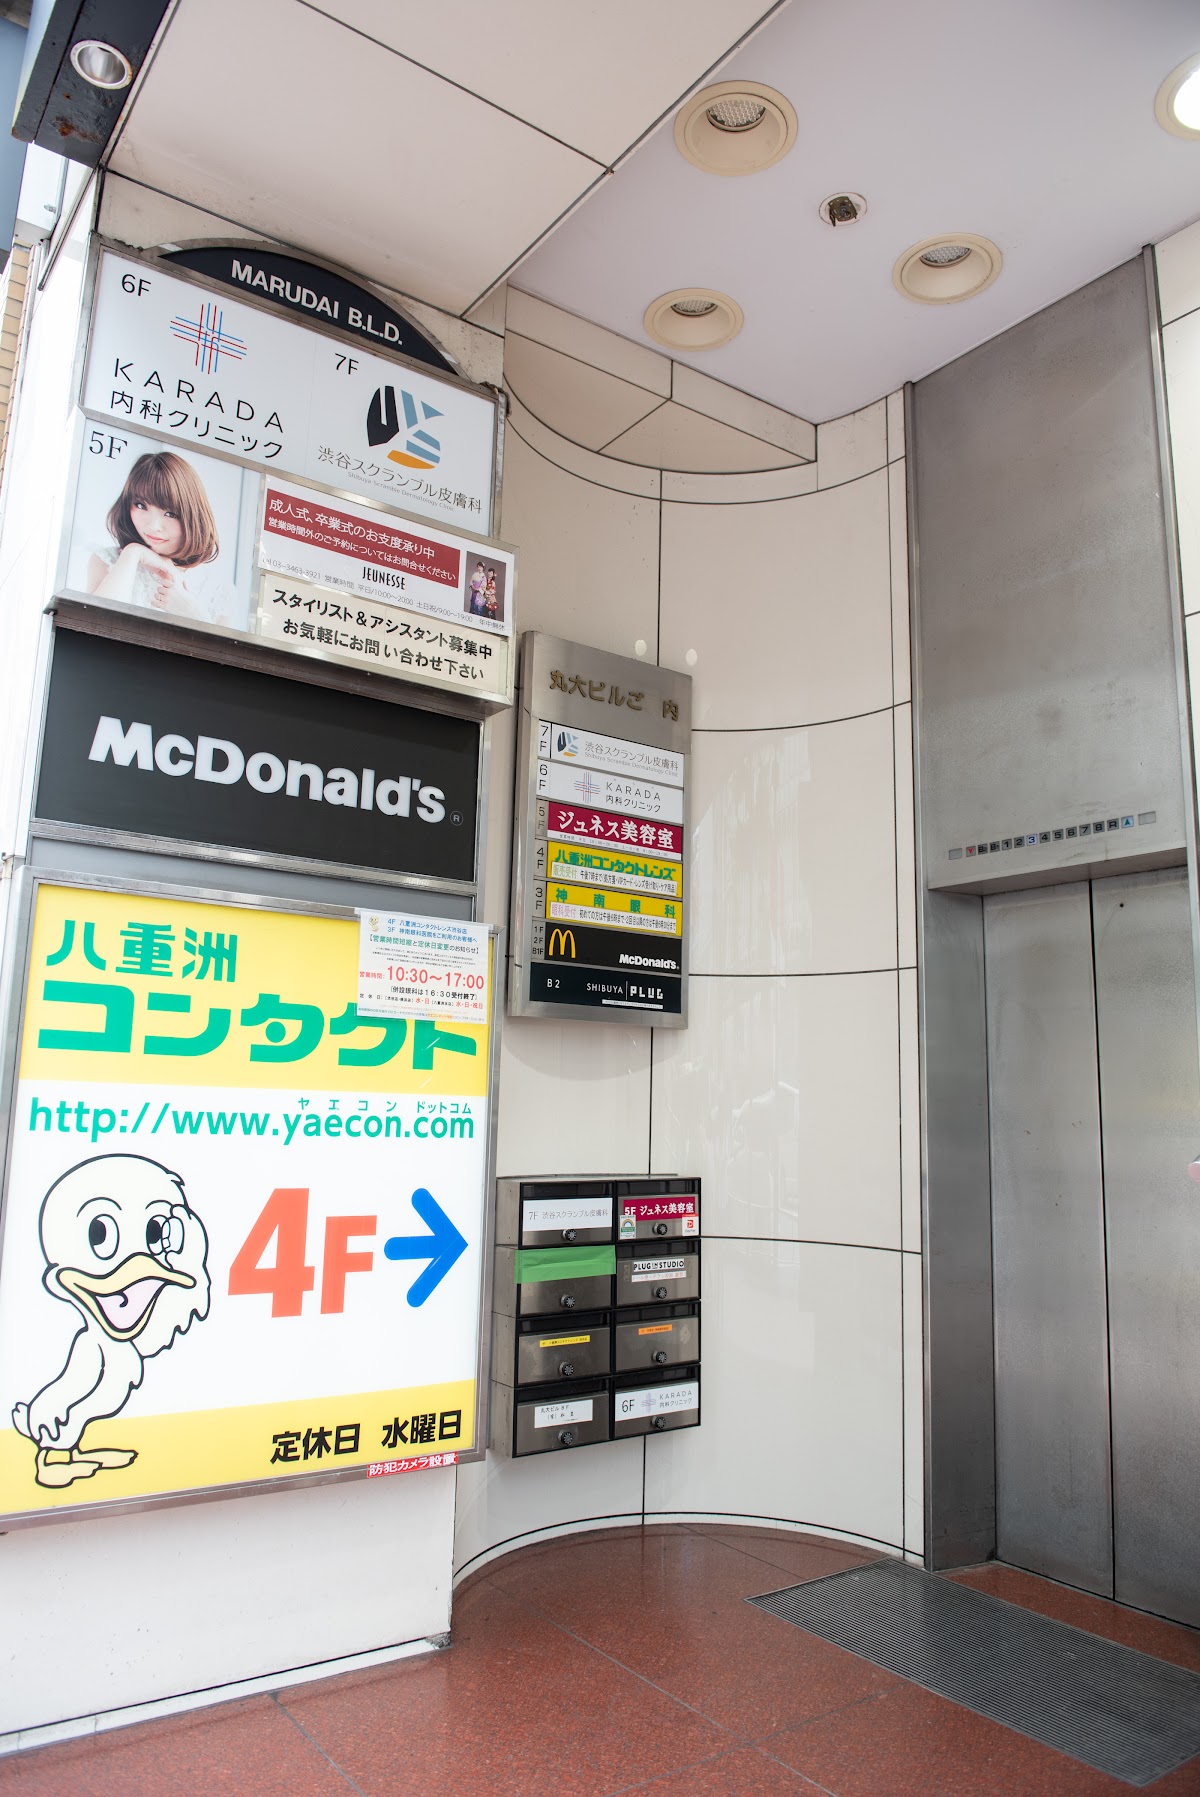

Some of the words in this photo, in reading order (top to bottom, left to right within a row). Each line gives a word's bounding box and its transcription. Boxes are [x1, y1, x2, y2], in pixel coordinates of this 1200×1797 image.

[121, 273, 152, 298] 6F
[231, 259, 339, 319] MARUDAI
[347, 307, 403, 345] B.L.D.
[334, 353, 359, 376] 7F
[114, 358, 284, 434] KARADA
[110, 390, 283, 459] 内科クリニック
[88, 431, 128, 460] 5F
[318, 445, 482, 513] 渋谷スクランブル皮膚科
[348, 471, 372, 485] Shibuya
[373, 479, 401, 494] Scramble
[401, 487, 437, 507] Dermatology
[438, 500, 455, 512] Clinic
[269, 498, 435, 559] 成人式、卒業式のお支度承り中
[268, 517, 456, 581] 営業時間外のご予約についてはお問合せください
[325, 575, 355, 590] 営業時間
[362, 566, 406, 590] JEUNESSE
[283, 618, 484, 680] お気軽にお問い合わせ下さい
[584, 740, 679, 771] 渋谷スクランブル皮膚科
[88, 716, 446, 824] McDonald's
[605, 781, 661, 801] KARADA
[605, 795, 661, 813] 内科クリニック
[557, 810, 674, 849] ジュネス美容室
[1016, 837, 1023, 846] 2
[1028, 835, 1036, 843] 3
[1041, 833, 1048, 841] 4
[1054, 831, 1061, 839] 5
[1068, 828, 1075, 837] 6
[1081, 825, 1088, 834] 7
[1095, 823, 1103, 832] 8
[1109, 820, 1117, 829] R
[552, 864, 577, 879] 販売受付
[555, 849, 676, 882] 八重洲コンタクトレンズ
[551, 903, 576, 918] 眼科受付
[46, 919, 238, 983] 八重洲
[619, 953, 677, 970] McDonald's
[586, 982, 624, 995] SHIBUYA
[630, 985, 664, 1000] PLUG
[38, 980, 476, 1071] コンタクト
[298, 1098, 398, 1112] ヤエコン
[415, 1101, 471, 1115] ドットコム
[29, 1097, 474, 1145] http://www.yaecon.com
[529, 1211, 538, 1220] 7F
[542, 1209, 608, 1220] 渋谷スクランブル皮膚科
[624, 1206, 636, 1216] 5F
[640, 1202, 694, 1216] ジュネス美容室
[227, 1188, 377, 1318] 4F
[634, 1262, 651, 1270] PLUG
[660, 1260, 684, 1268] STUDIO
[622, 1399, 635, 1413] 6F
[659, 1390, 692, 1400] KARADA
[659, 1398, 692, 1408] 内科クリニック
[270, 1423, 361, 1465] 定休日
[381, 1410, 462, 1449] 水曜日
[369, 1453, 457, 1477] 防犯カメラ設置
